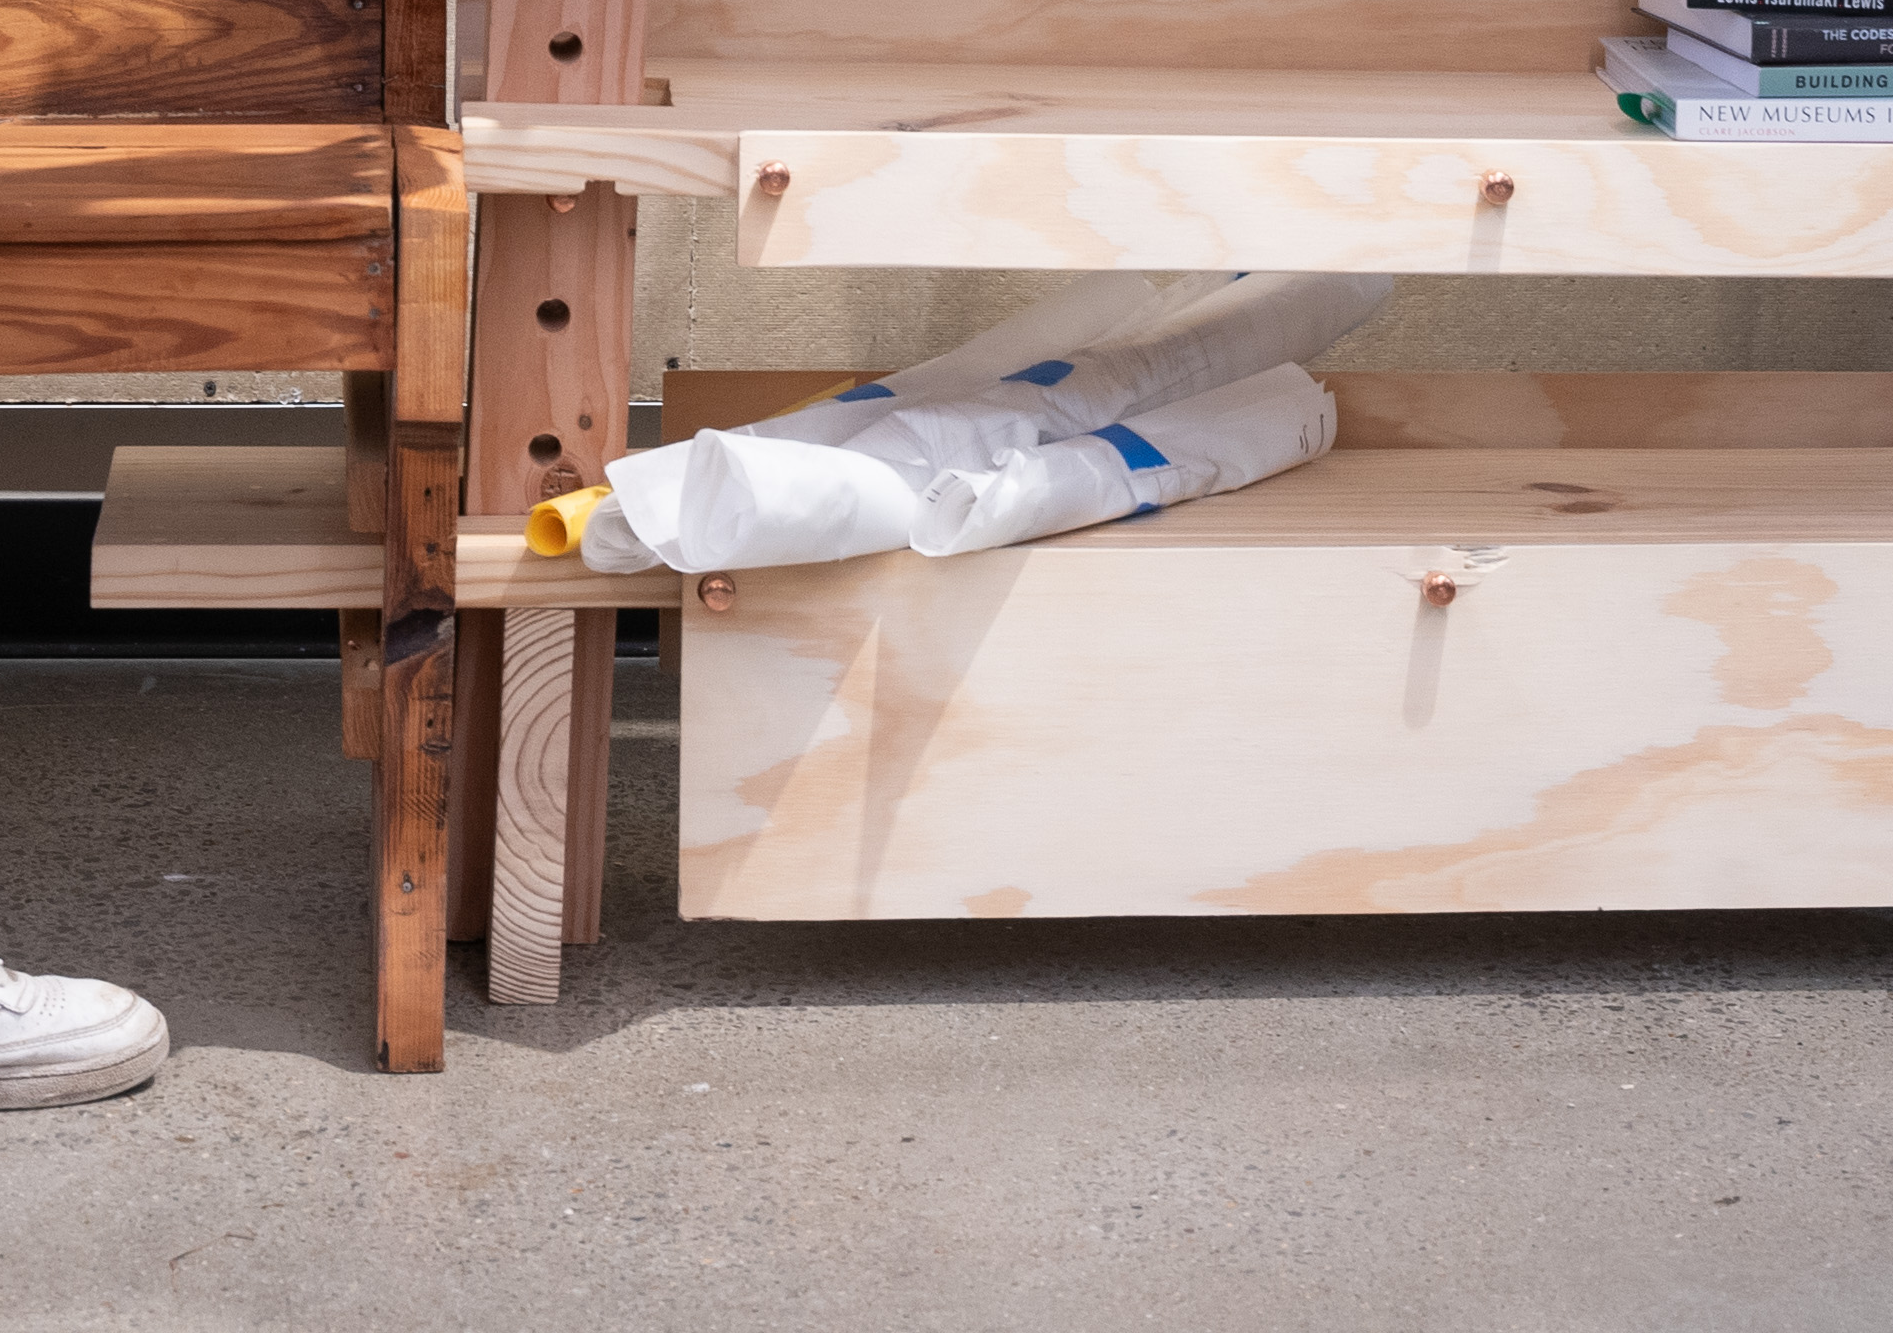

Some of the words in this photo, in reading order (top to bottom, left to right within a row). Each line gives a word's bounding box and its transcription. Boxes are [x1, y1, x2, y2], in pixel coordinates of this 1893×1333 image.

[1822, 28, 1848, 41] THE
[1795, 74, 1888, 89] BUILDING
[1698, 105, 1752, 122] NEW
[1762, 106, 1876, 123] MUSEUMS
[1698, 127, 1733, 136] CLARE
[1738, 127, 1796, 137] JACOBSON
